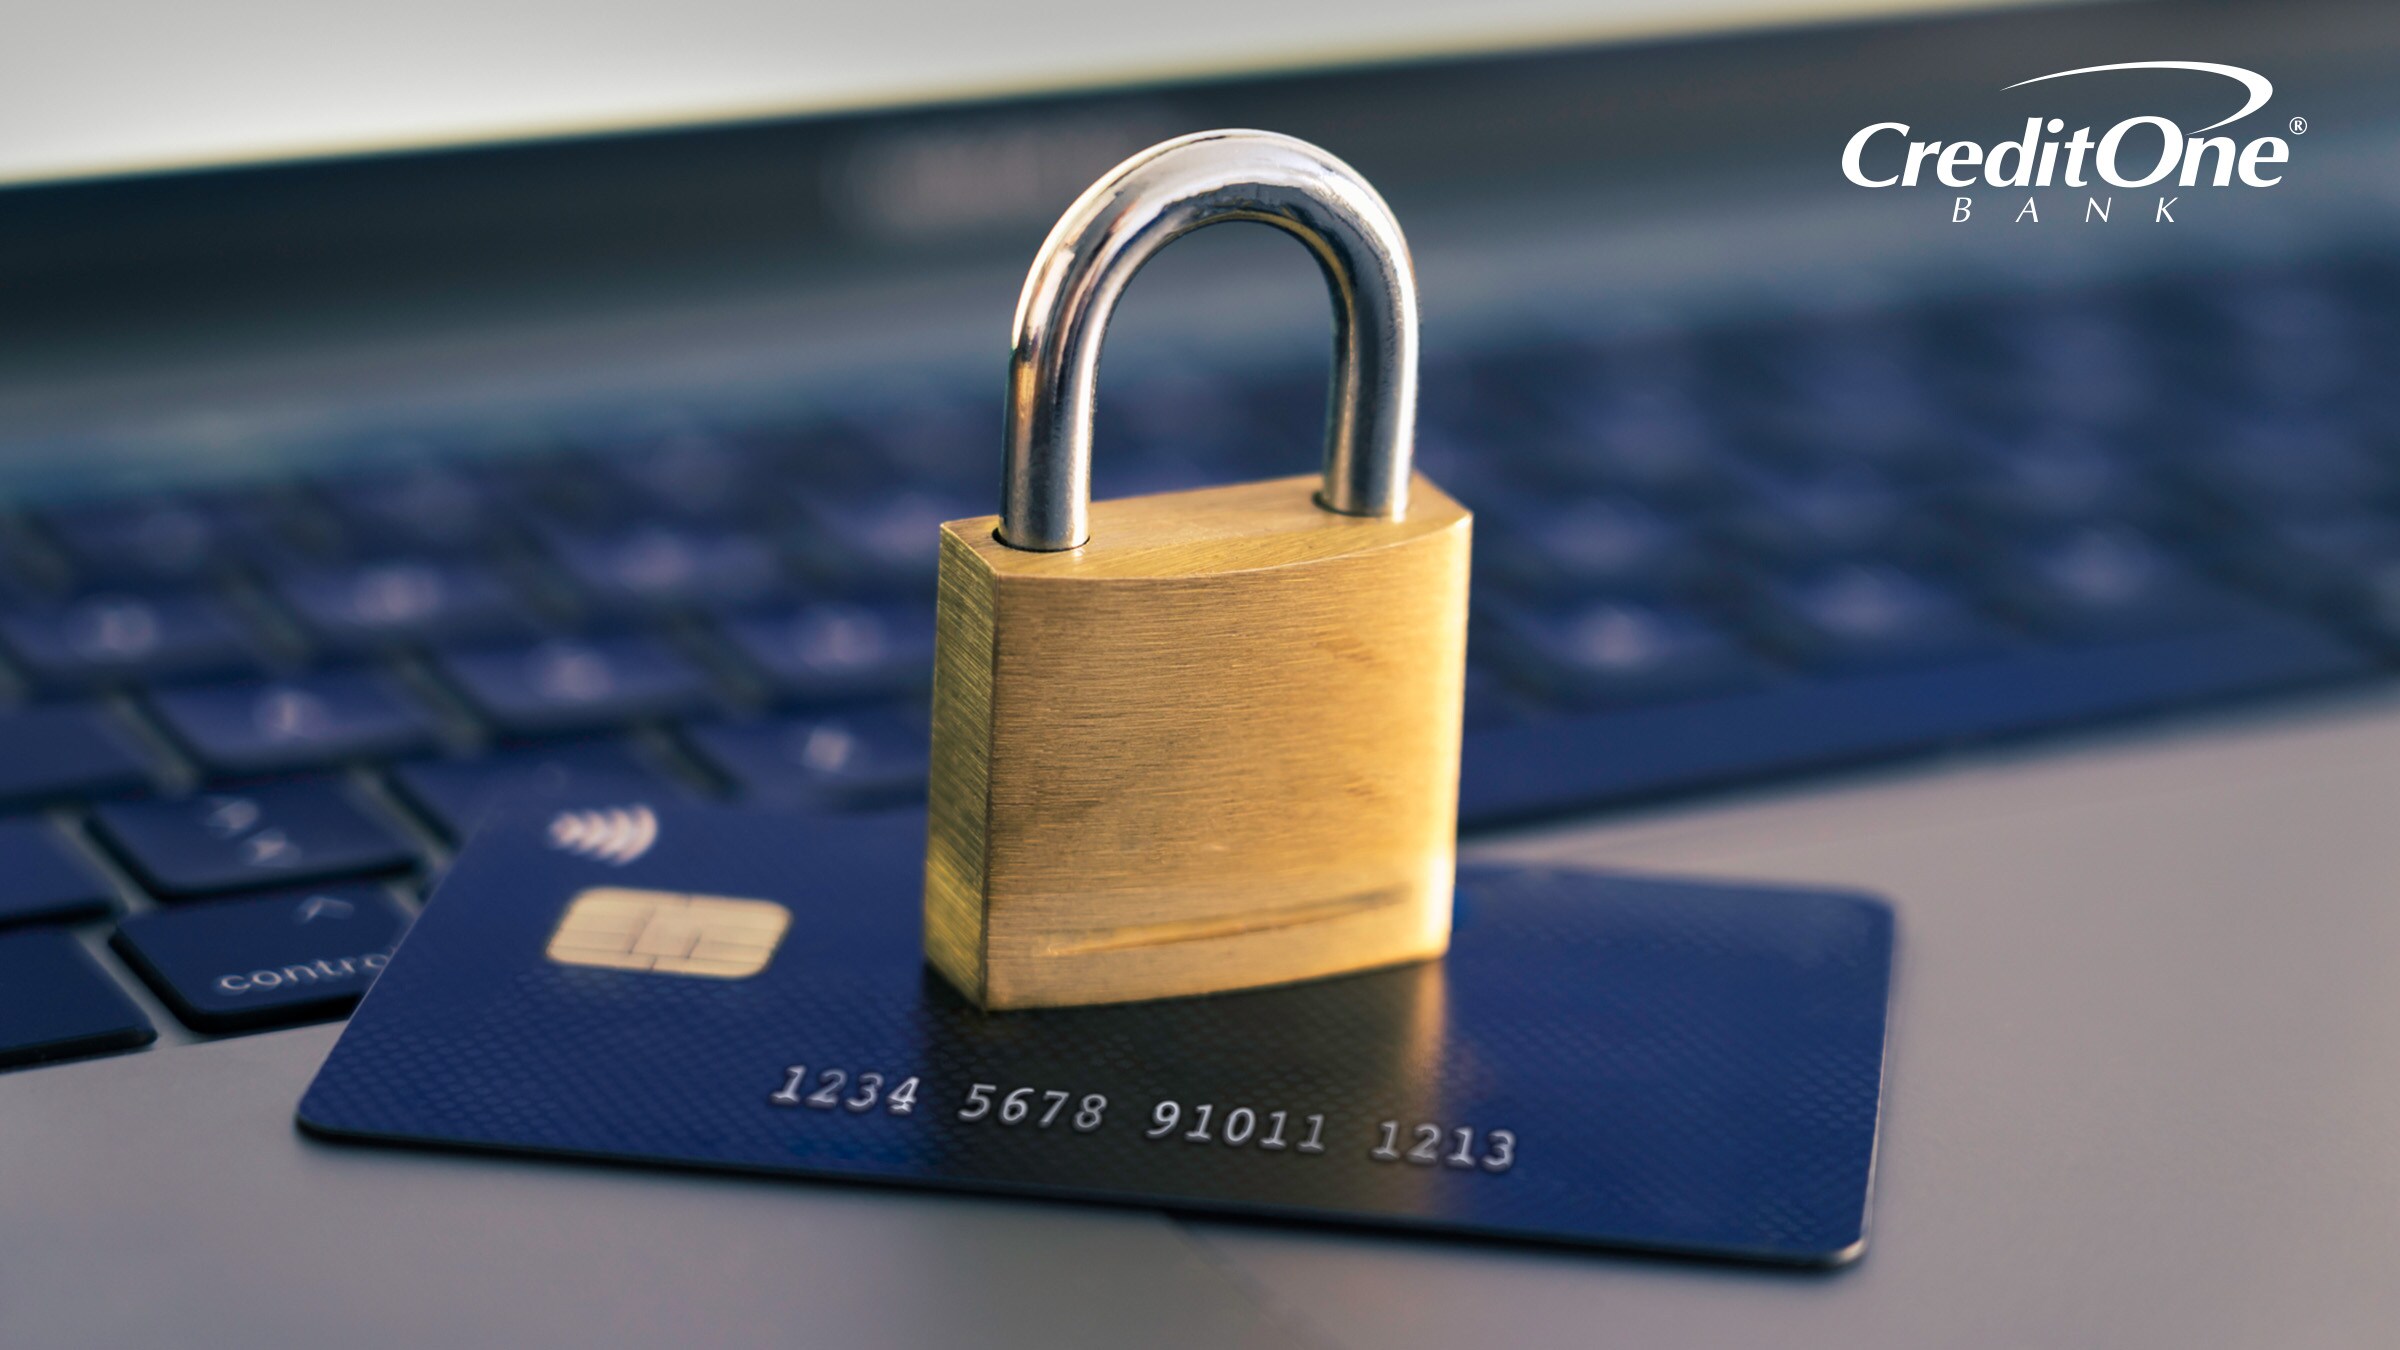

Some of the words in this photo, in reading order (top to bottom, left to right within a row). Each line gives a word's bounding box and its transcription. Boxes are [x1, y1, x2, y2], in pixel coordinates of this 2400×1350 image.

[218, 947, 396, 991] contro
[771, 1064, 920, 1115] 1234
[957, 1083, 1108, 1131] 5678
[1145, 1100, 1326, 1153] 91011
[1371, 1120, 1516, 1171] 1213
